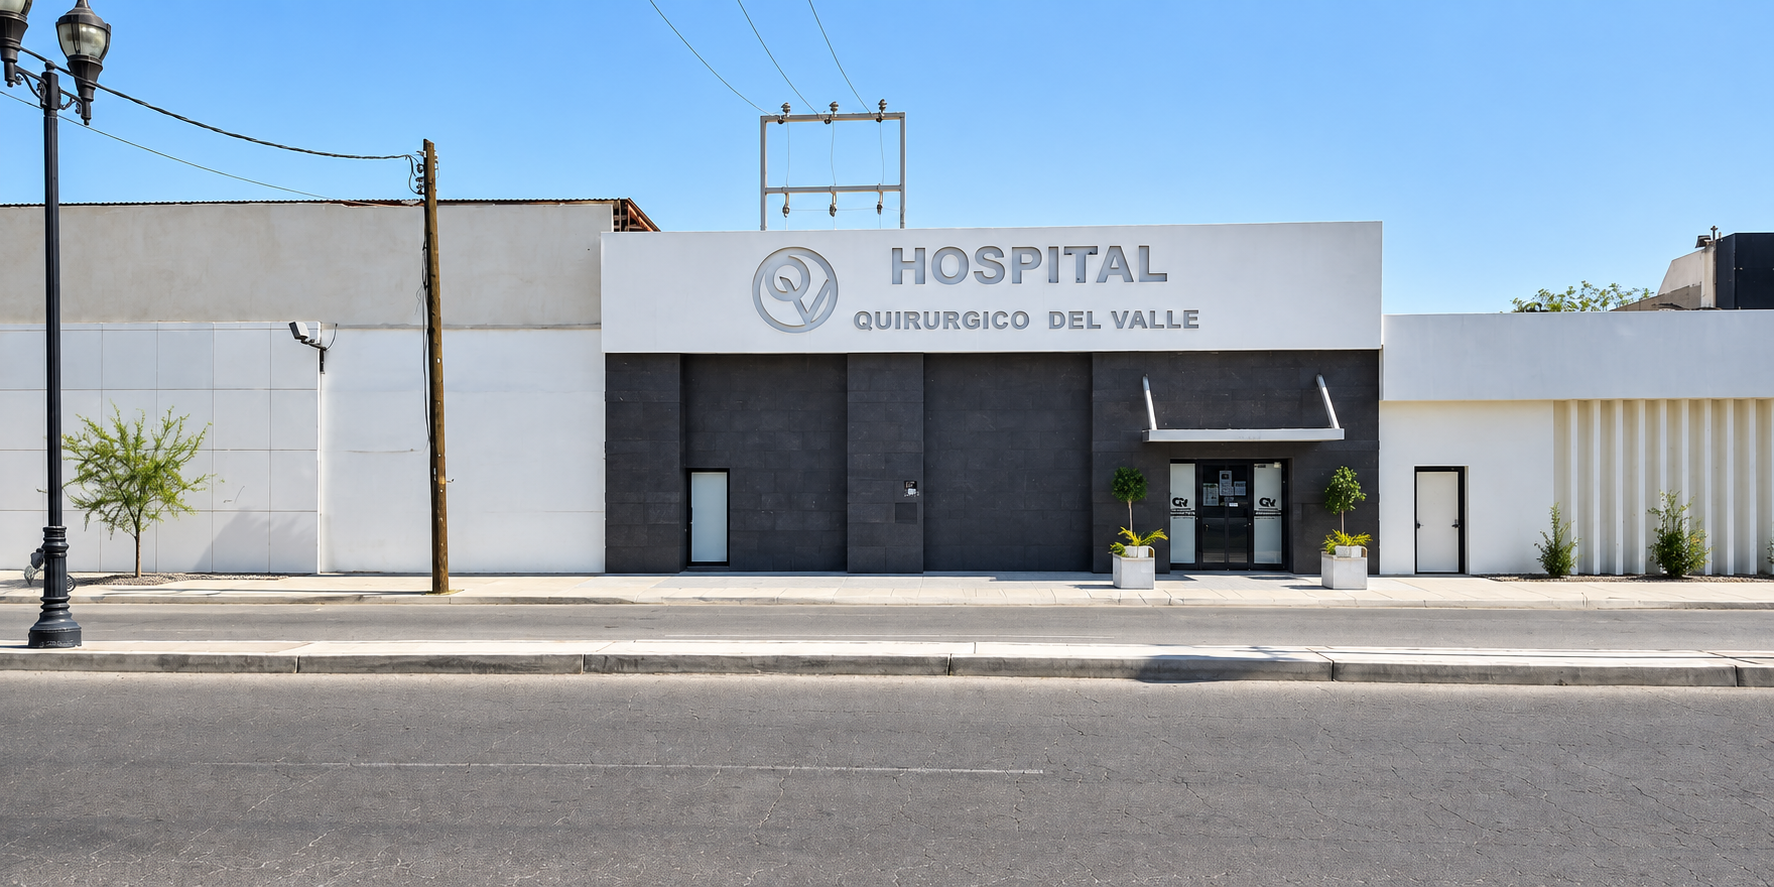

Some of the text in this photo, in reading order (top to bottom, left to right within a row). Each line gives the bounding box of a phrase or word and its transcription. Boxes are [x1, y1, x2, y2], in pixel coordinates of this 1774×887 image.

[891, 245, 1168, 284] HOSPITAL
[853, 310, 1200, 332] QUIRURGICO DEL VALLE
